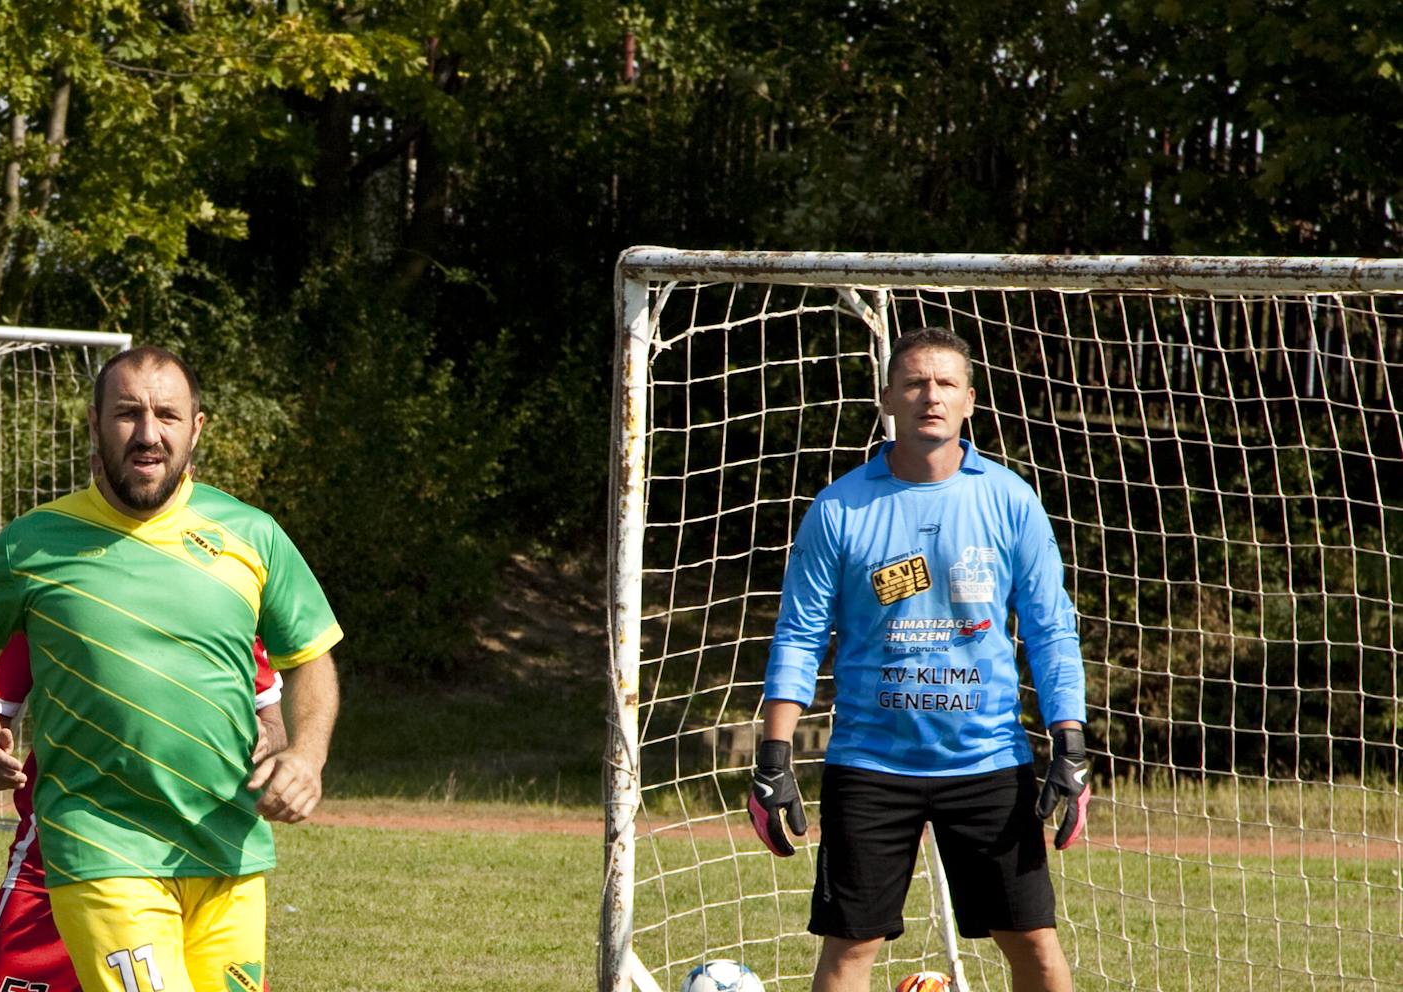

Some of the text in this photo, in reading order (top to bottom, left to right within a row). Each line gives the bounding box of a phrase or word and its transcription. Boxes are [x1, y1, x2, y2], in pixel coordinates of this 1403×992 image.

[874, 573, 886, 587] K
[889, 569, 897, 578] &
[899, 564, 910, 576] V
[912, 558, 929, 588] STAV
[879, 691, 981, 711] GENERALI
